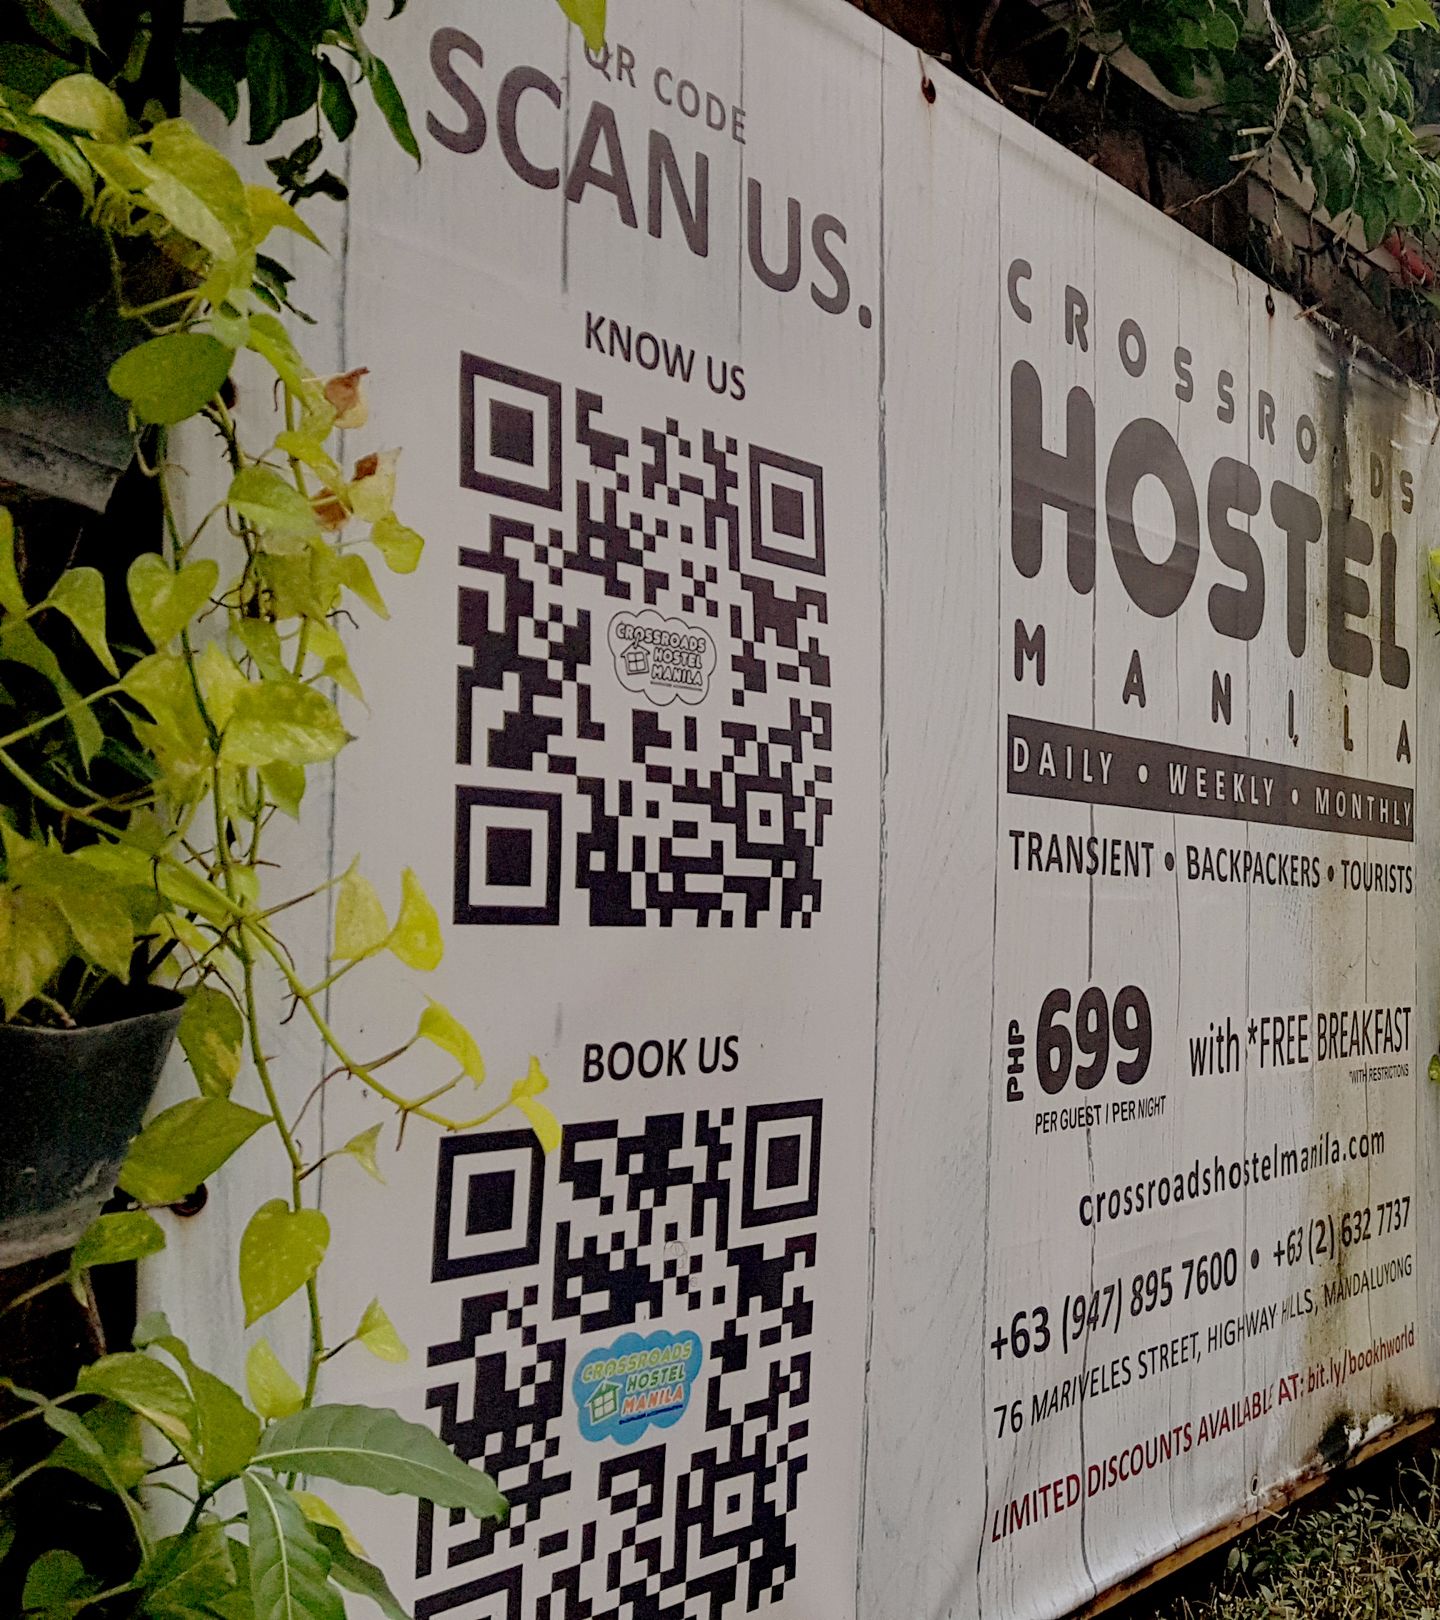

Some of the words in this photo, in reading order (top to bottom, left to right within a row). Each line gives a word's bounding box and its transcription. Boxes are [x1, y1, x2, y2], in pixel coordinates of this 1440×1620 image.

[584, 40, 636, 88] QR
[654, 67, 747, 144] CODE
[426, 26, 709, 258] SCAN
[747, 176, 872, 328] US.
[585, 311, 695, 383] KNOW
[707, 355, 746, 401] US
[1007, 258, 1414, 514] CROSSRODS
[1010, 359, 1411, 689] HOSTEL
[615, 622, 707, 653] CROSSROADS
[651, 664, 703, 686] MANILA
[652, 647, 703, 669] HOSTEL
[1013, 619, 1412, 764] MANILA
[1012, 736, 1113, 785] DAILY
[1168, 762, 1275, 807] WEEKLY
[1315, 787, 1413, 827] MONTHLY
[1009, 830, 1154, 878] TRANSIENT
[1187, 845, 1320, 888] BACKPACKERS
[1342, 859, 1413, 894] TOURISTS
[583, 1038, 687, 1083] BOOK
[698, 1035, 739, 1074] US
[1007, 1019, 1025, 1102] PHP
[1036, 985, 1152, 1094] 699
[1189, 1017, 1240, 1077] with
[1317, 1007, 1411, 1061] BREAKFAST
[1368, 1063, 1408, 1081] RESTRICTIONS
[1035, 1111, 1057, 1134] PER
[1060, 1104, 1102, 1131] GUEST
[1112, 1102, 1135, 1122] PER
[1138, 1096, 1166, 1118] NIGHT
[1079, 1130, 1385, 1226] crossroadshostelmanila.com
[990, 1306, 1051, 1360] +63
[1062, 1278, 1122, 1353] (947)
[1130, 1266, 1173, 1317] 895
[1181, 1247, 1237, 1300] 7600
[1273, 1226, 1303, 1268] +63
[1308, 1214, 1334, 1265] (2)
[1341, 1208, 1371, 1248] 632
[1376, 1196, 1411, 1237] 7737
[582, 1340, 692, 1383] CROSSROADS
[626, 1363, 686, 1393] HOSTEL
[994, 1400, 1023, 1438] 76
[1030, 1356, 1131, 1426] MARIVELES
[1138, 1332, 1201, 1378] STREET,
[1208, 1304, 1277, 1354] HIGHWAY
[1323, 1254, 1412, 1307] MANDALUYONG
[621, 1384, 684, 1416] MANILA
[992, 1475, 1080, 1542] LIMITED
[1087, 1423, 1192, 1498] DISCOUNTS
[1308, 1322, 1415, 1394] bit.ly/bookhworld
